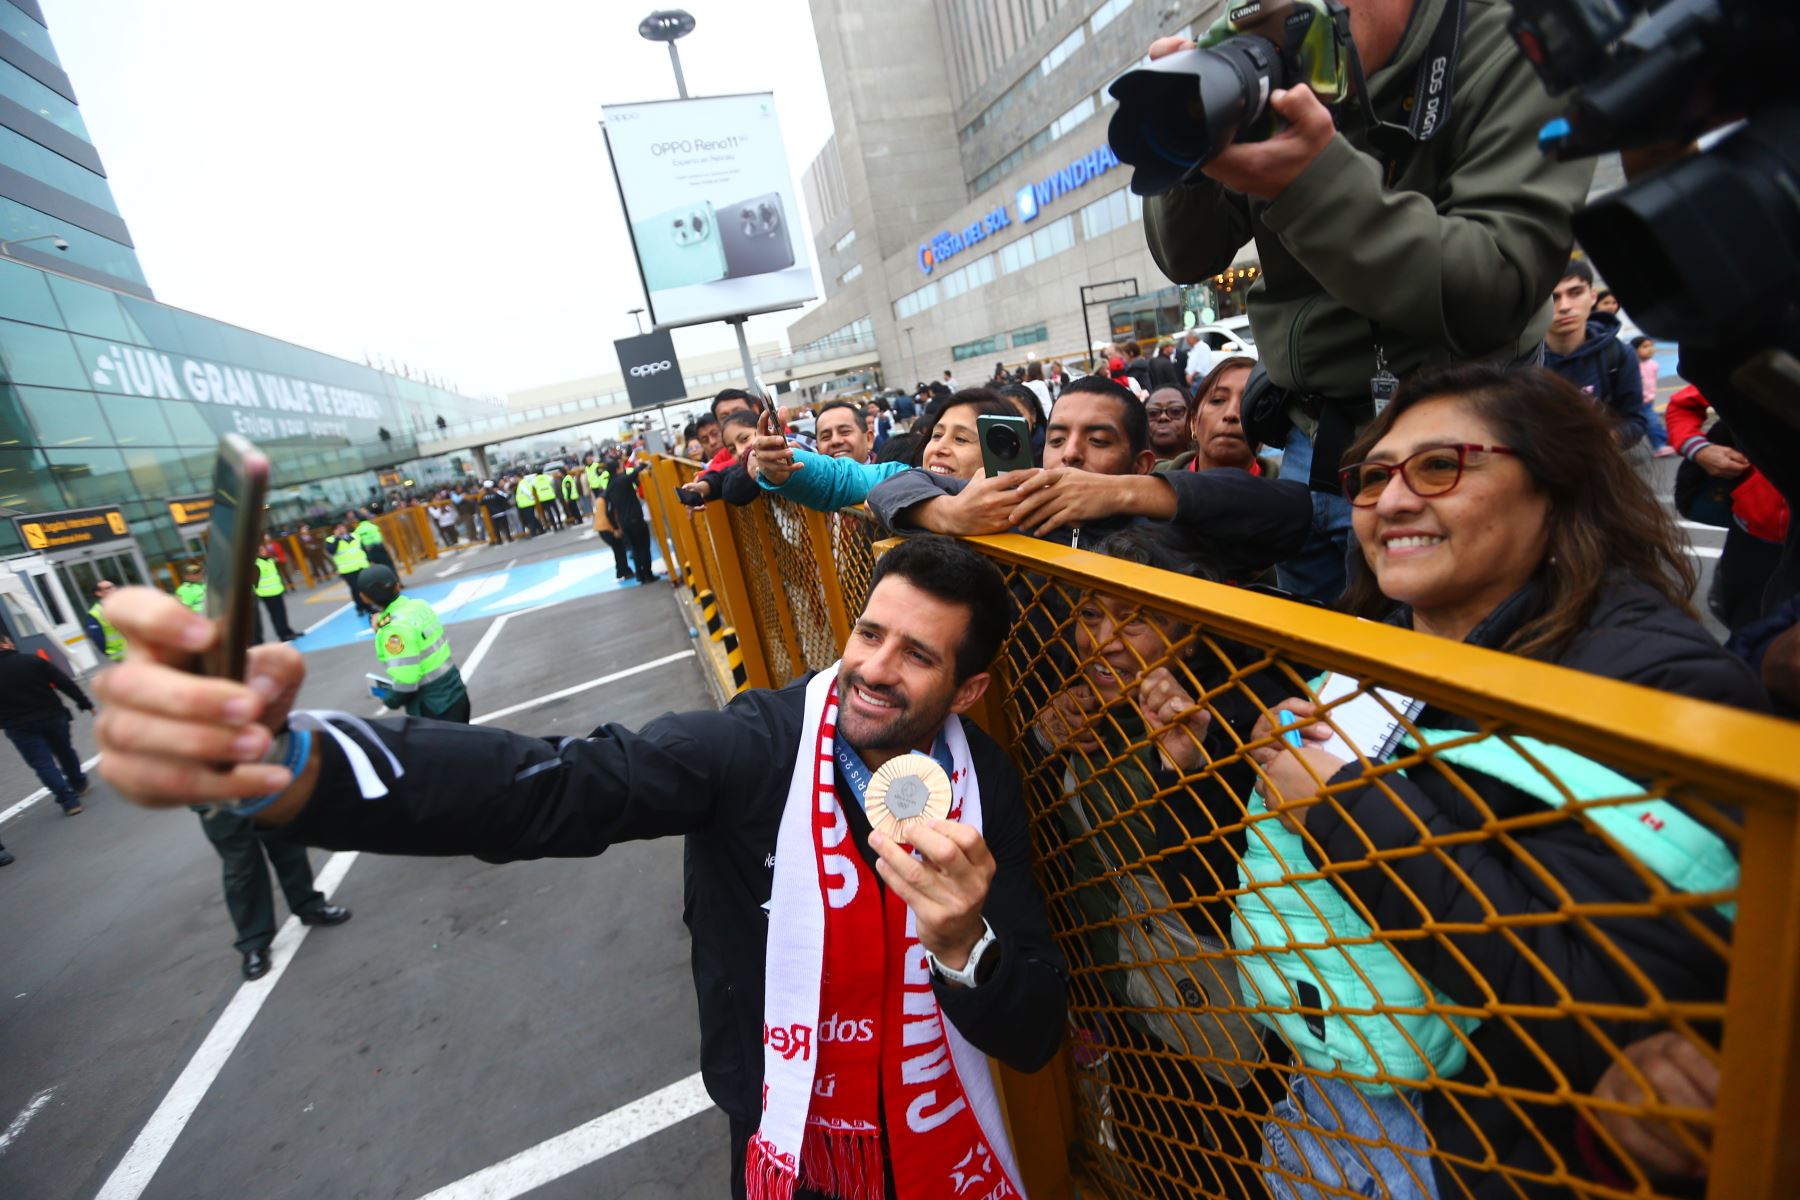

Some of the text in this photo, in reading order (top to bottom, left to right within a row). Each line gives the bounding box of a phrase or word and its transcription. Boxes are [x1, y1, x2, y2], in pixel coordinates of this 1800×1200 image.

[1430, 56, 1447, 94] EOS
[609, 112, 639, 123] oppo
[651, 142, 693, 157] OPPO
[695, 136, 739, 152] Reno11
[1034, 144, 1121, 206] WYNDHA
[932, 233, 964, 263] COSTA
[962, 220, 987, 247] DEL
[984, 206, 1012, 234] SOL
[630, 359, 672, 378] oppo
[182, 359, 261, 408] GRAN
[256, 372, 315, 414] VIAJE
[308, 381, 333, 416] TE
[232, 410, 276, 439] Enjoy
